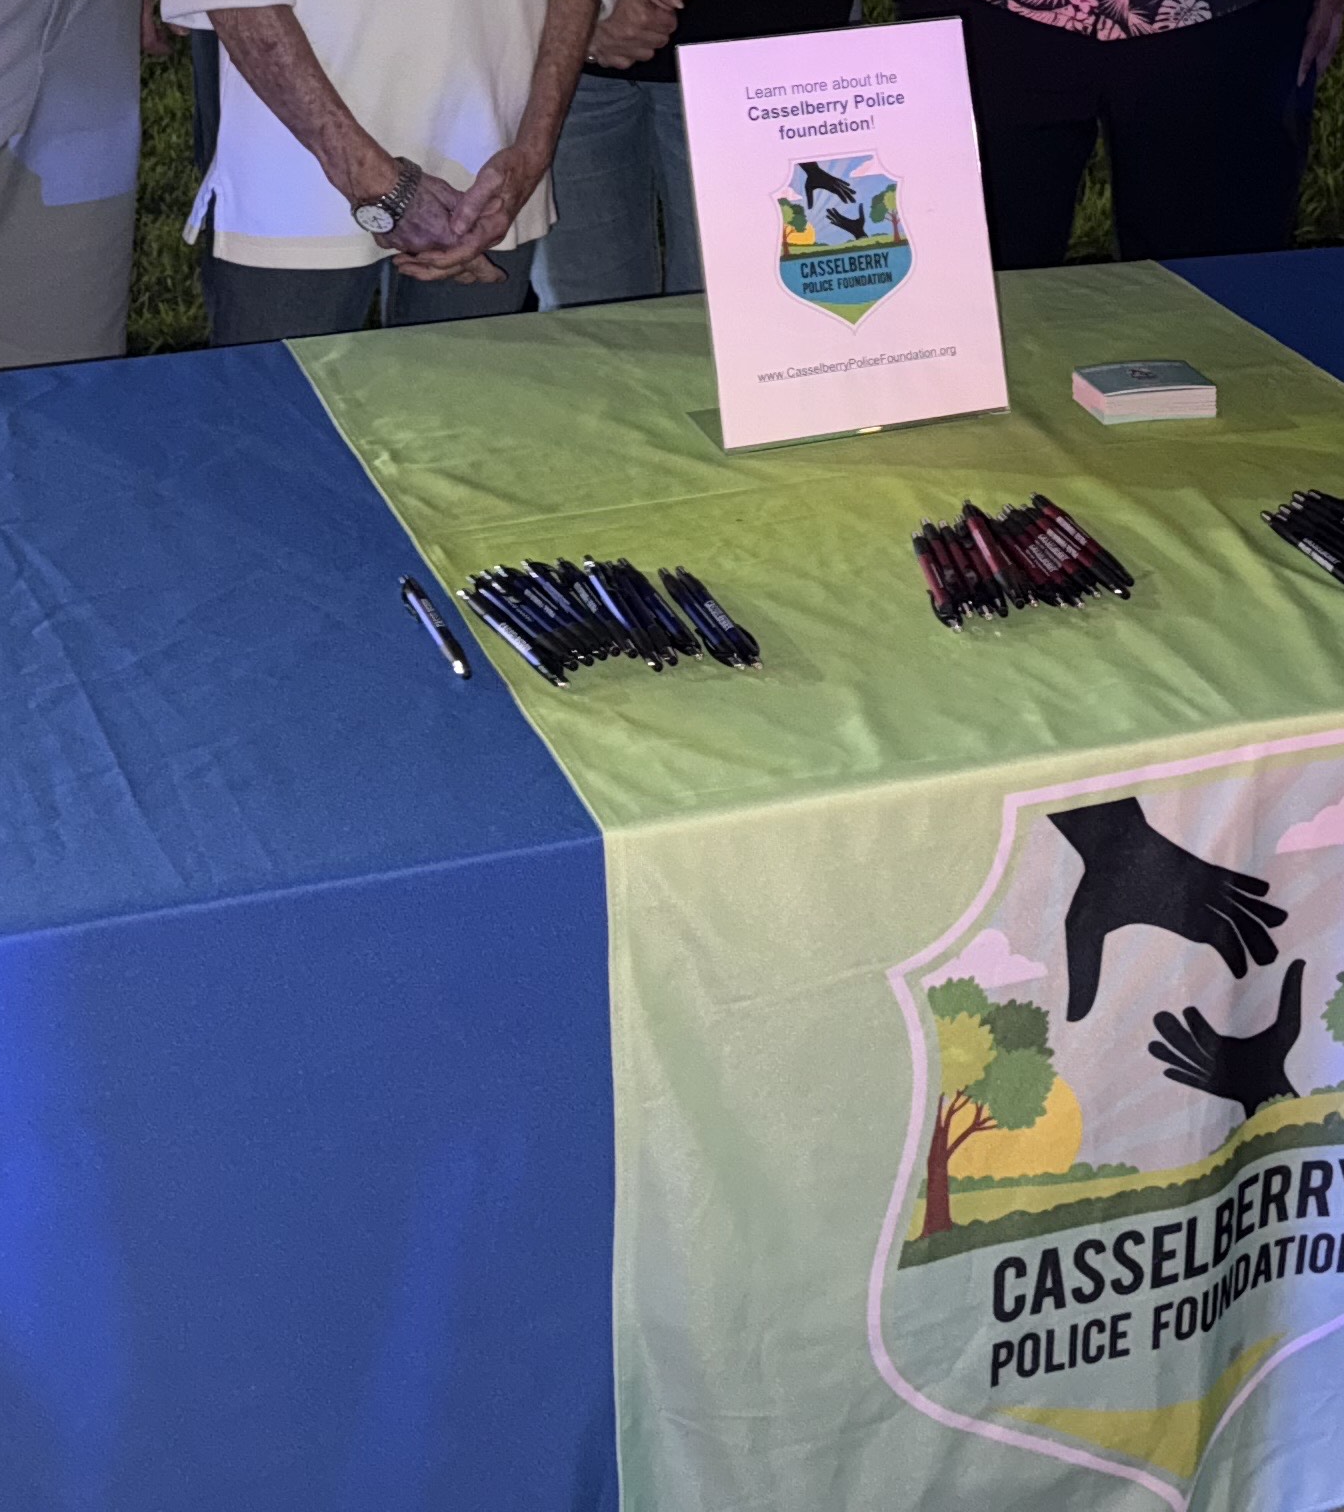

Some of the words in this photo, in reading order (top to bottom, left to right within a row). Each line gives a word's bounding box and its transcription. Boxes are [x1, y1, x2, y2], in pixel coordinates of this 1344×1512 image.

[745, 85, 787, 100] Learn
[791, 81, 828, 95] more
[832, 74, 872, 90] about
[875, 72, 897, 86] the
[748, 100, 848, 121] Casselberry
[854, 92, 905, 109] Police
[778, 115, 876, 140] foundation!
[800, 251, 889, 279] CASSELBERRY
[803, 279, 834, 294] POLICE
[838, 272, 893, 290] FOUNDATION
[990, 1312, 1132, 1388] POLICE
